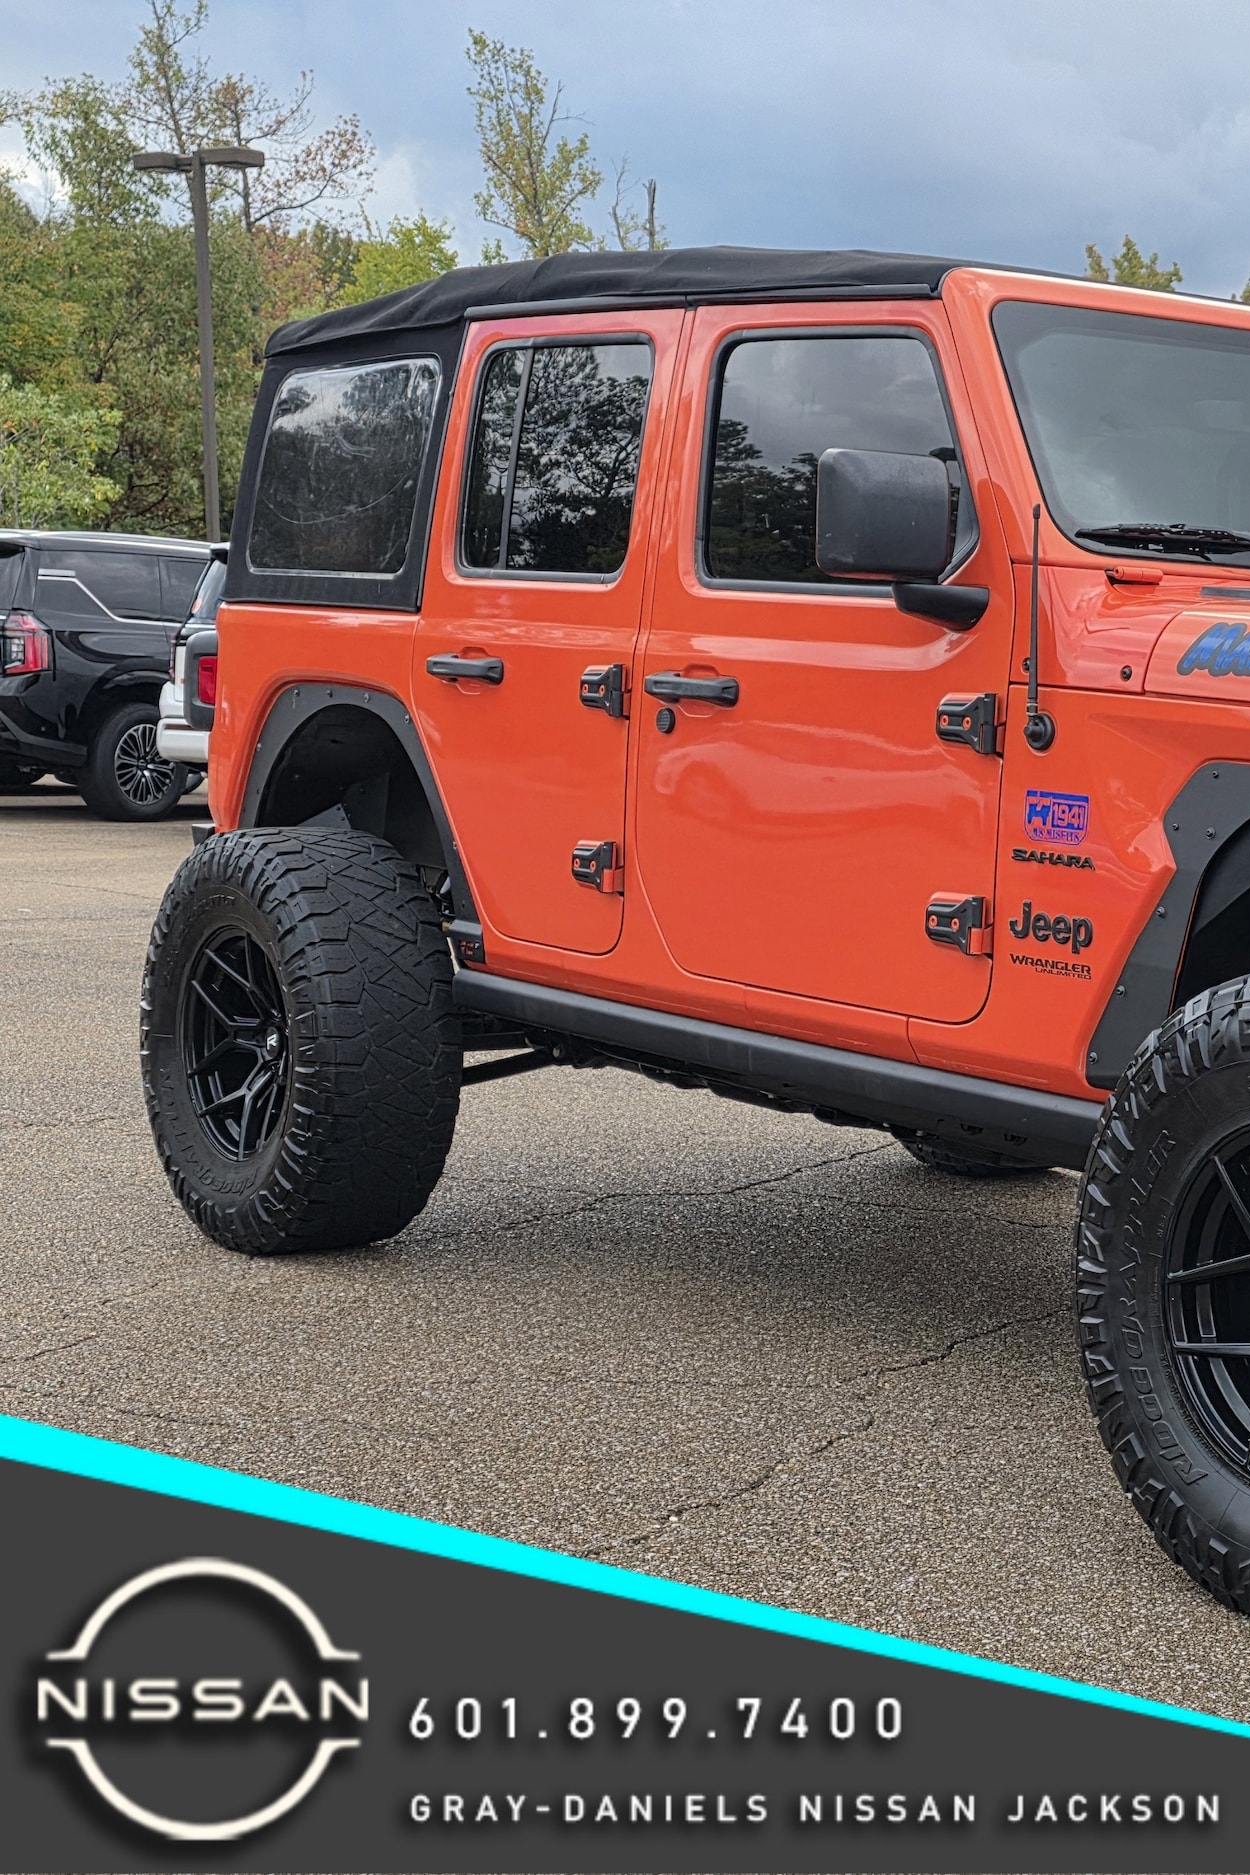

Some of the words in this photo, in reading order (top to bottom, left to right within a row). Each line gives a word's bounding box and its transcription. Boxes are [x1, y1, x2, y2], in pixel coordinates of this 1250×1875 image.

[1052, 803, 1085, 829] 1941
[1011, 848, 1096, 871] SAHARA
[1009, 900, 1094, 955] Jeep
[1009, 953, 1092, 976] WRANGLER
[1035, 967, 1092, 980] UNLIMITED
